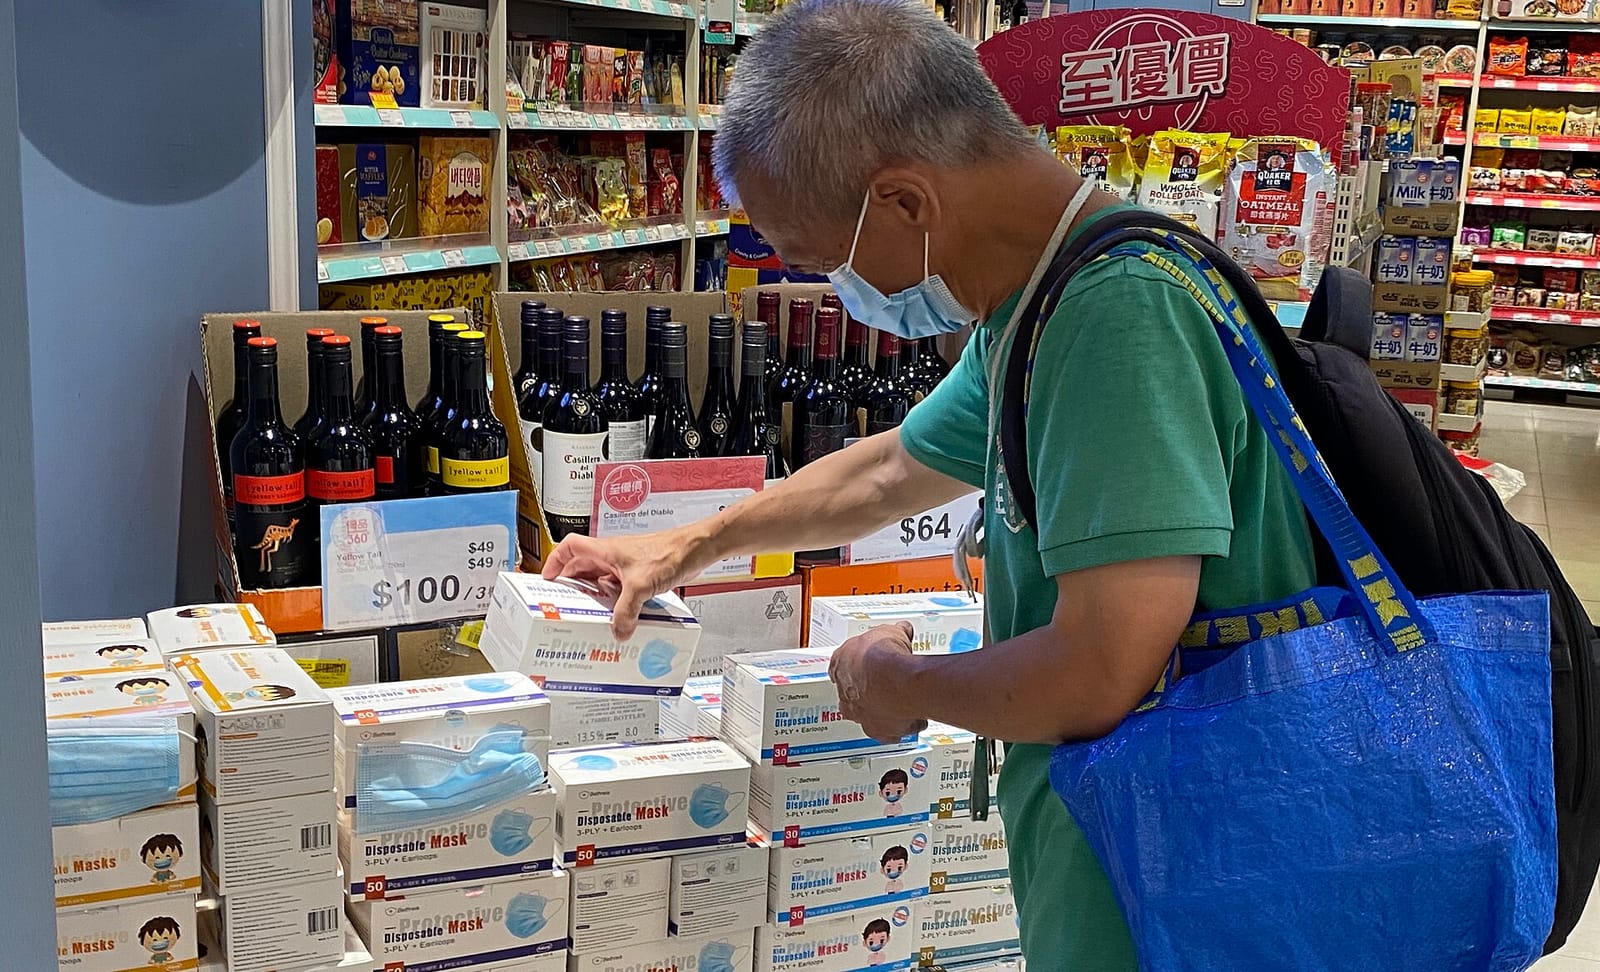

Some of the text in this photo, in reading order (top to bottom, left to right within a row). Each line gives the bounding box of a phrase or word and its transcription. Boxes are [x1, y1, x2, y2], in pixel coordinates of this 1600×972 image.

[1060, 34, 1230, 112] 至優價
[1172, 167, 1197, 176] QUAKER
[1257, 170, 1292, 181] QUAKER
[1149, 190, 1183, 200] ROLLED
[1255, 193, 1287, 201] INSTANT
[1396, 186, 1454, 201] Milk 牛奶
[1240, 200, 1300, 212] OATMEAL
[1380, 263, 1409, 278] 牛奶
[1416, 264, 1445, 280] 牛奶
[1373, 340, 1402, 355] 牛奶
[1408, 341, 1437, 357] 牛奶
[564, 454, 601, 464] Casillero
[569, 470, 594, 480] Diabl
[608, 480, 643, 496] 至優價
[603, 508, 674, 520] Casillero del Diablo
[900, 512, 952, 547] $64
[468, 541, 495, 555] $49
[336, 550, 383, 562] Yellow Tail
[467, 556, 494, 571] $49
[372, 574, 460, 611] $100
[535, 648, 622, 663] Disposable Mask
[561, 662, 593, 670] Earloops
[689, 668, 723, 678] CABERN
[343, 686, 445, 701] Disposable Mask
[357, 710, 375, 719] 50
[789, 703, 838, 718] Protec
[774, 709, 844, 728] Disposable Mas
[624, 726, 639, 738] 8.0
[774, 724, 829, 737] 3-PLY Earloops
[773, 748, 787, 758] 30
[940, 769, 971, 782] Dispos
[800, 782, 876, 804] Protective
[939, 782, 959, 791] 3-PLY
[591, 794, 688, 818] Protective
[785, 790, 865, 811] Disposable Masks
[939, 803, 952, 812] 30
[577, 803, 669, 828] Disposable Mask
[785, 809, 806, 818] 3-PLY
[380, 822, 488, 847] Protective
[576, 823, 643, 837] 3-PLY Earloops
[784, 829, 798, 839] 30
[365, 831, 468, 857] Disposable Mask
[945, 829, 1004, 848] Protect
[577, 851, 593, 861] 50
[932, 843, 980, 857] Disposable
[73, 857, 117, 874] Masks
[364, 852, 439, 867] 3-PLY Earloops
[931, 853, 988, 865] 3-PLY Earloops
[804, 860, 878, 883] Protective
[366, 881, 384, 893] 50
[791, 869, 867, 892] Disposable Masks
[931, 877, 945, 887] 30
[790, 890, 811, 900] 3-PLY
[399, 906, 503, 933] Protective
[790, 910, 804, 921] 30
[933, 902, 1014, 924] Protective
[922, 911, 998, 932] Disposable Mask
[384, 915, 484, 945] Disposable Mask
[920, 927, 976, 940] 3-PLY Earloops
[72, 938, 116, 955] Masks
[384, 943, 410, 955] 3-PLY
[786, 934, 859, 955] Protective
[772, 942, 849, 964] Disposable Masks
[920, 951, 934, 961] 30
